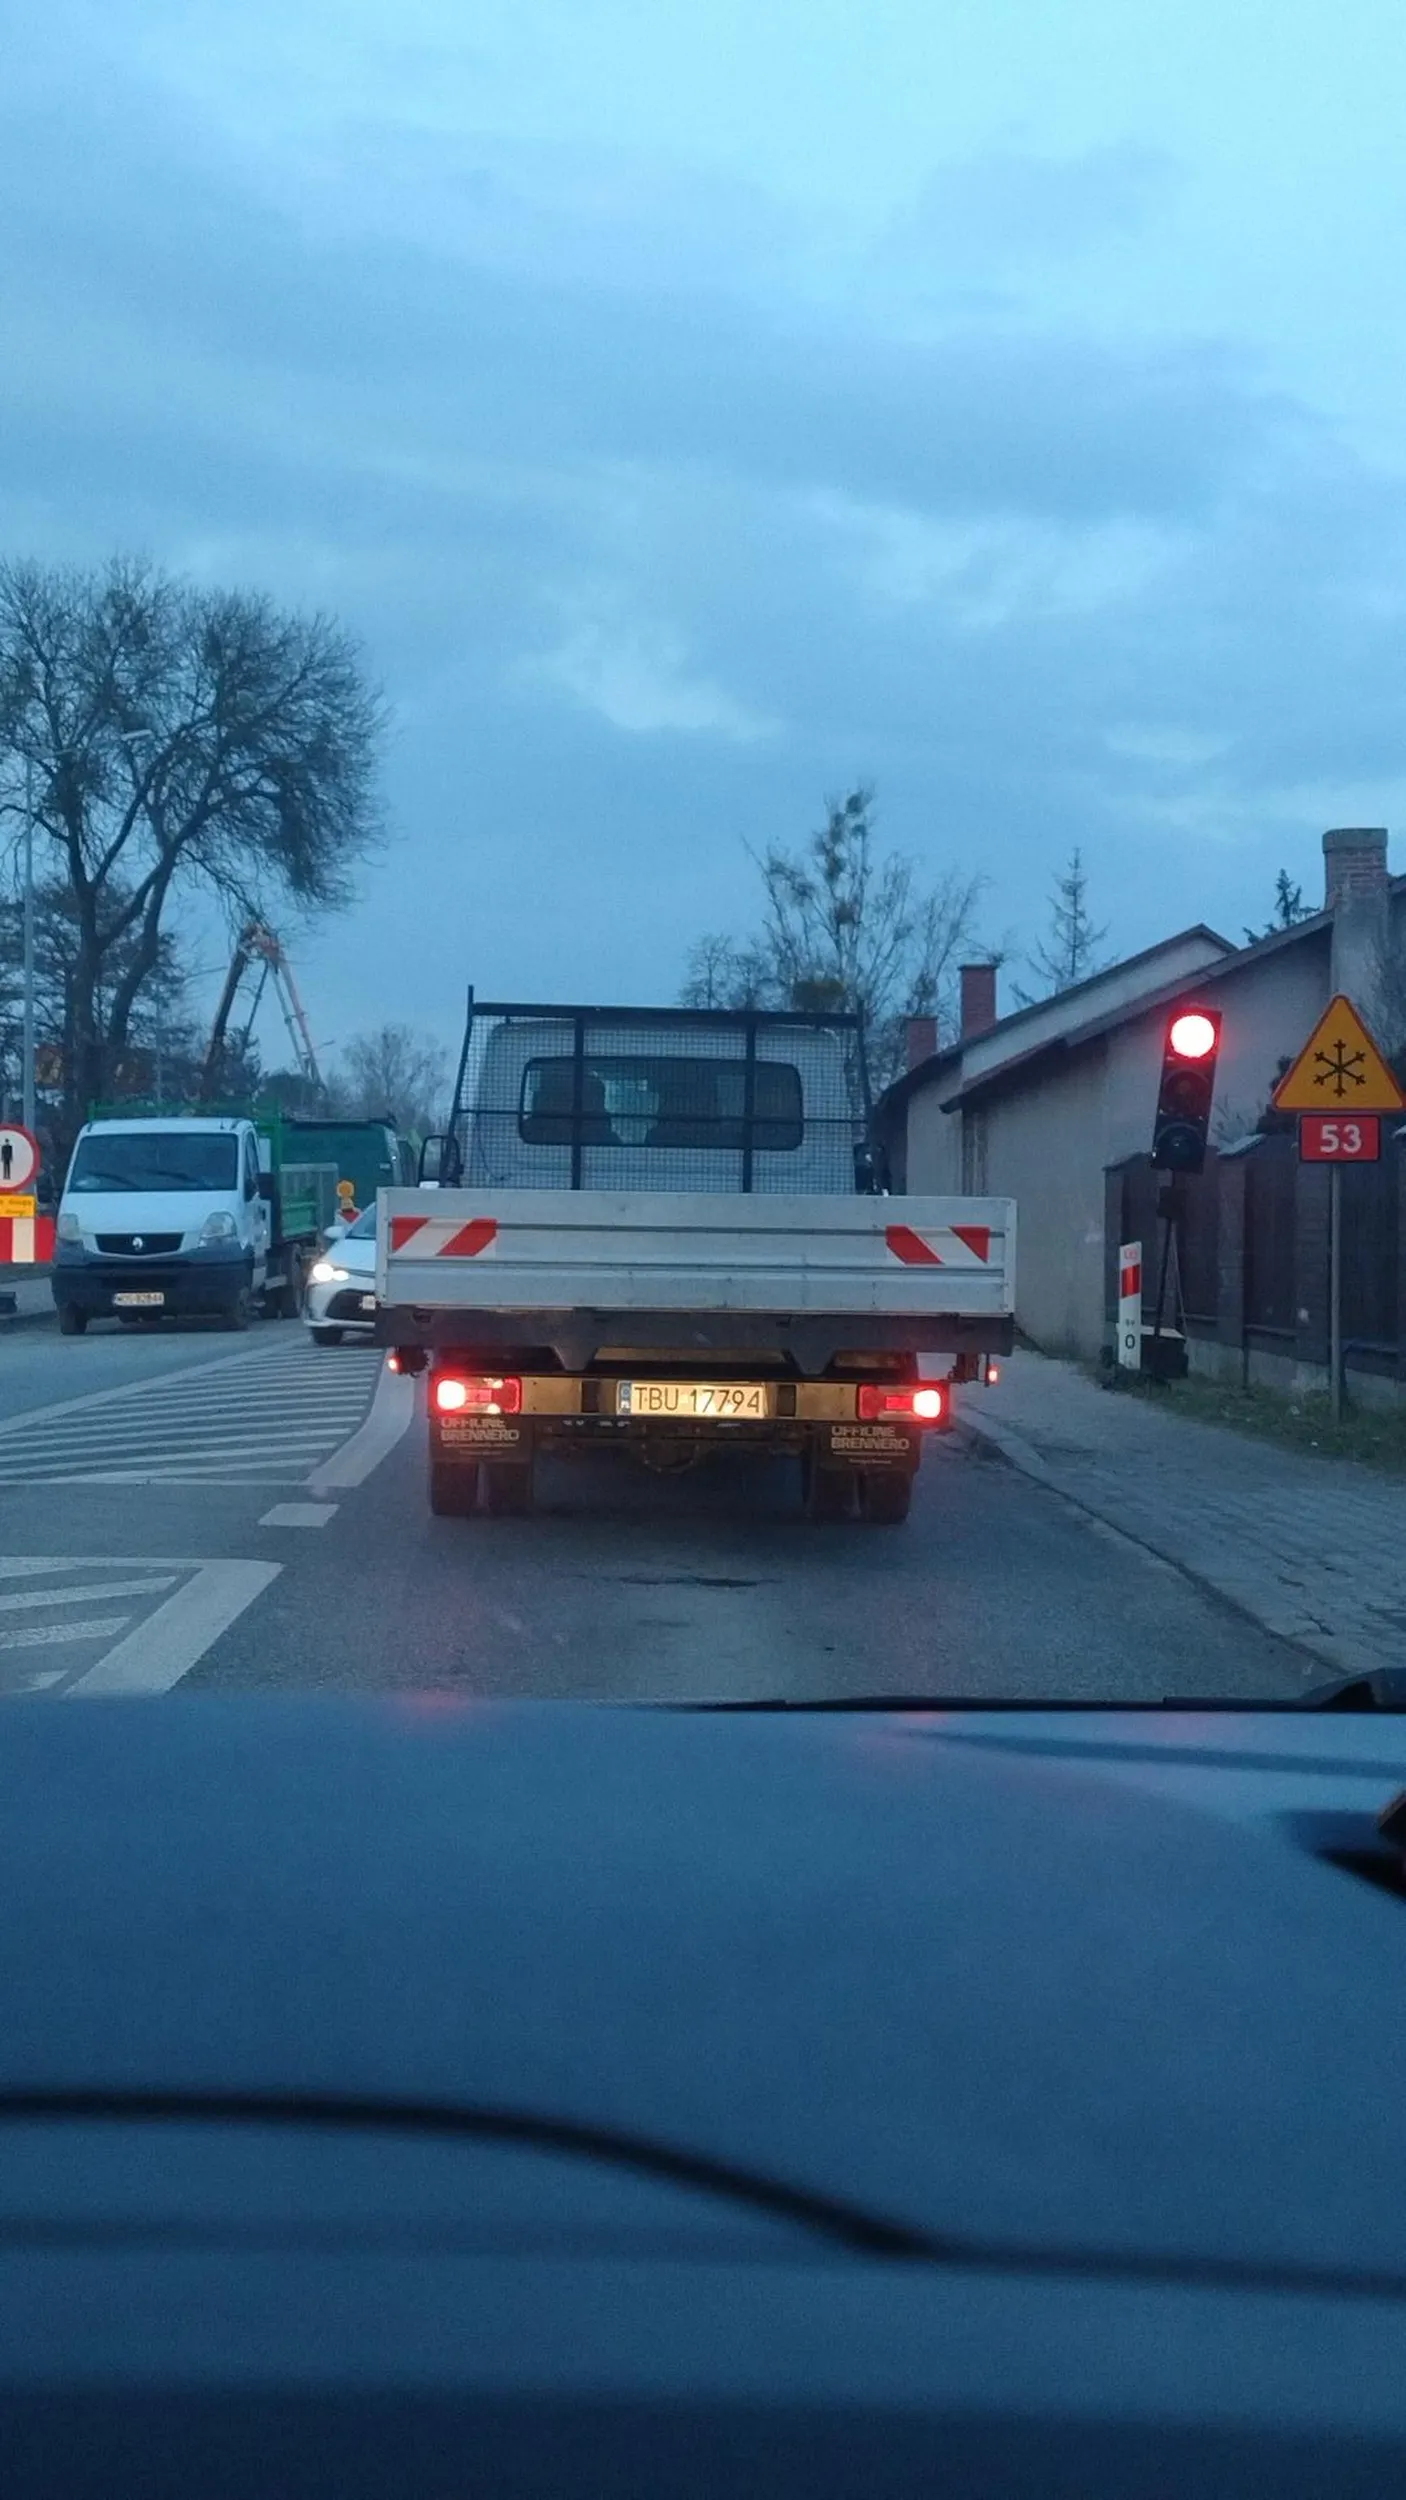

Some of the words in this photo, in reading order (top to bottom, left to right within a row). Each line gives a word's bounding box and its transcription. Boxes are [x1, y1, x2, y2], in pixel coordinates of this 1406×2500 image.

[1320, 1124, 1361, 1153] 53
[634, 1387, 679, 1411] TBU
[689, 1389, 760, 1413] 17794
[441, 1429, 519, 1441] BRENNERO
[831, 1437, 910, 1450] BRENNERO
